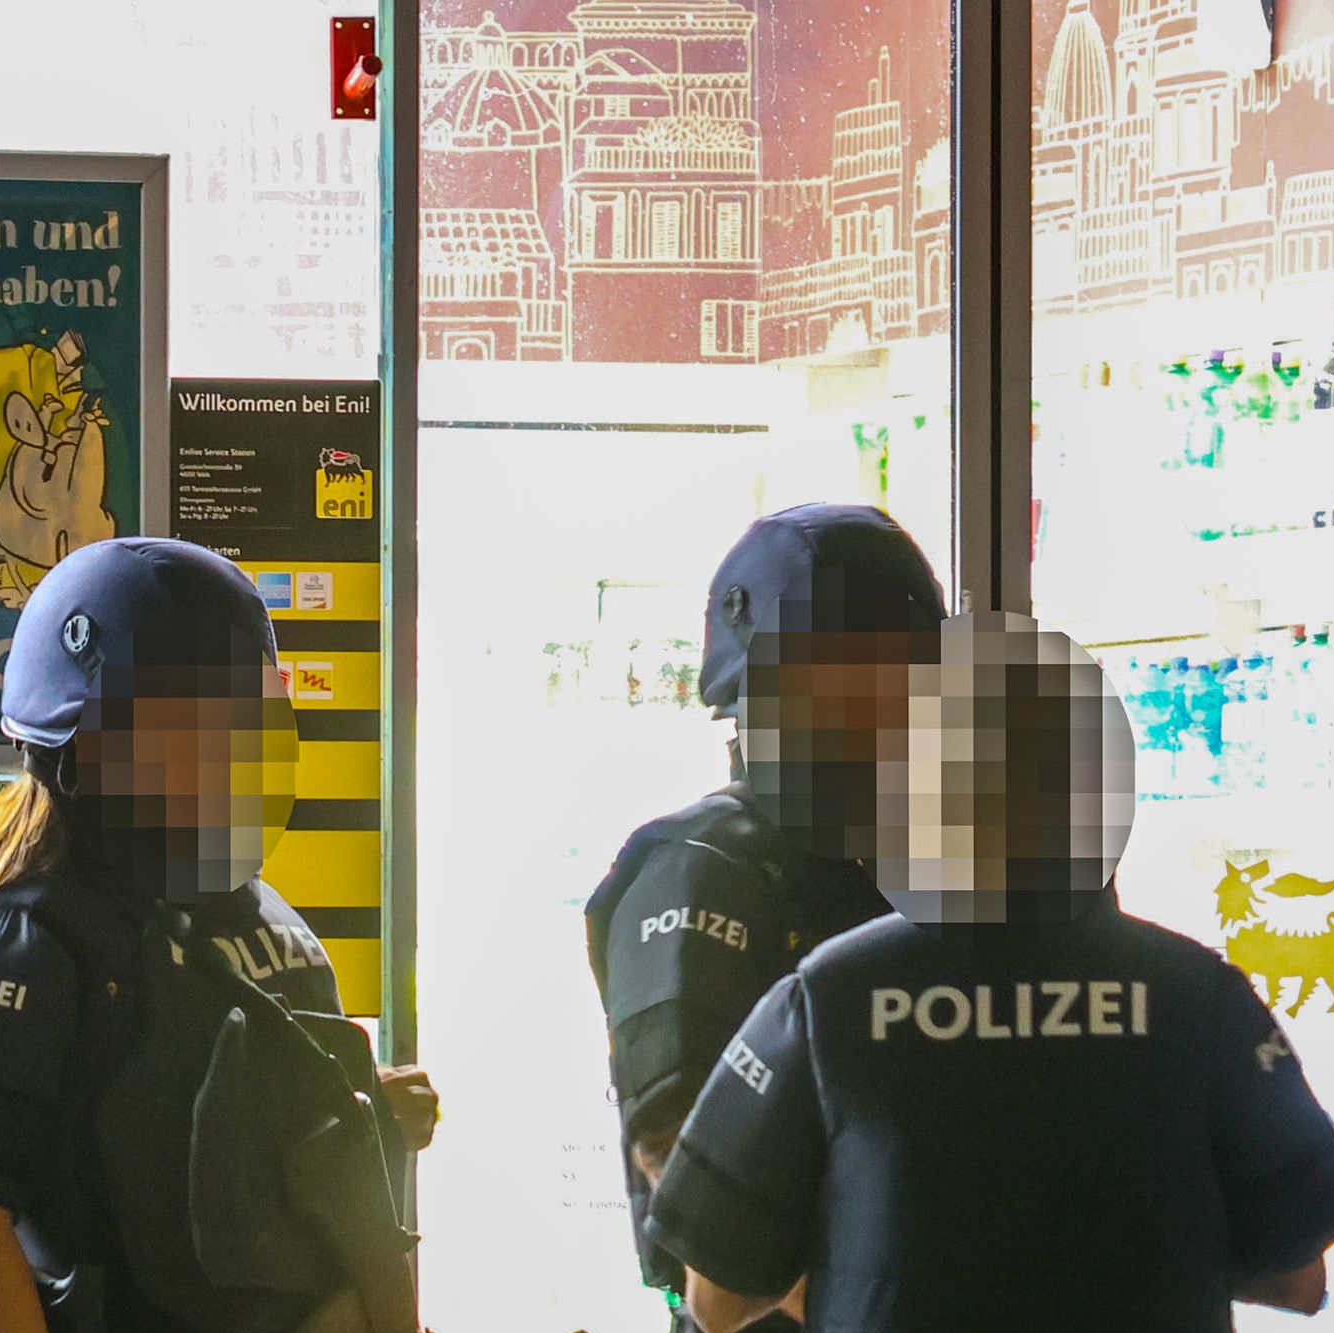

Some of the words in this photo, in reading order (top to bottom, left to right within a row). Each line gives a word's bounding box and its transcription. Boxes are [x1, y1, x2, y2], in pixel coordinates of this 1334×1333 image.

[34, 211, 121, 250] und
[178, 393, 296, 412] Willkommen
[303, 395, 329, 413] bei
[335, 396, 370, 413] Eni!
[323, 492, 365, 517] eni
[871, 982, 1148, 1040] POLIZEI
